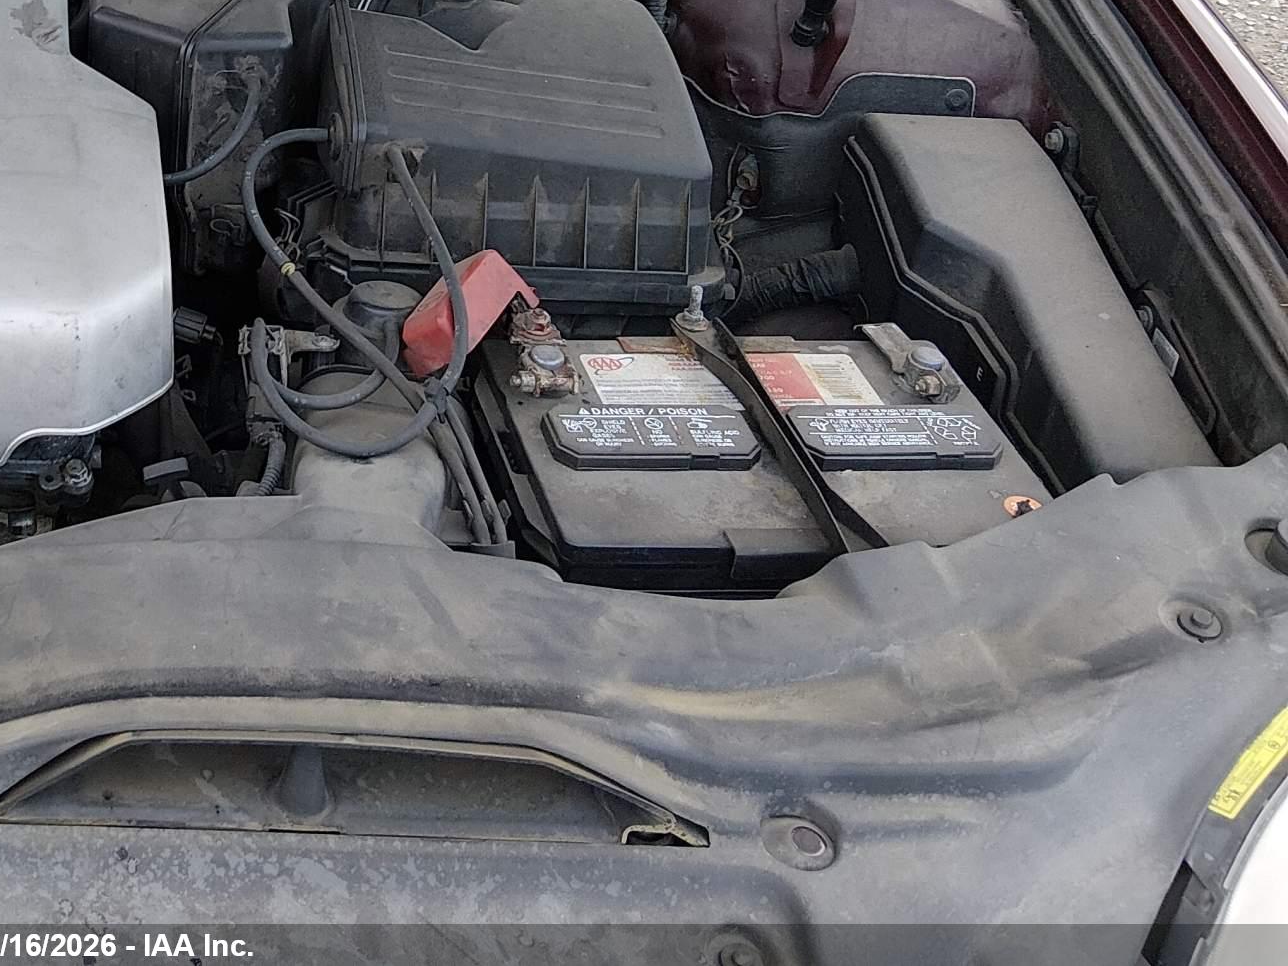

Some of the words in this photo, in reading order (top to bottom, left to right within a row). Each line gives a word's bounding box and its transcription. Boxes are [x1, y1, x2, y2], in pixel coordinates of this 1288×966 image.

[588, 357, 622, 371] AAA
[591, 407, 645, 416] DANGER
[659, 407, 708, 416] POISON
